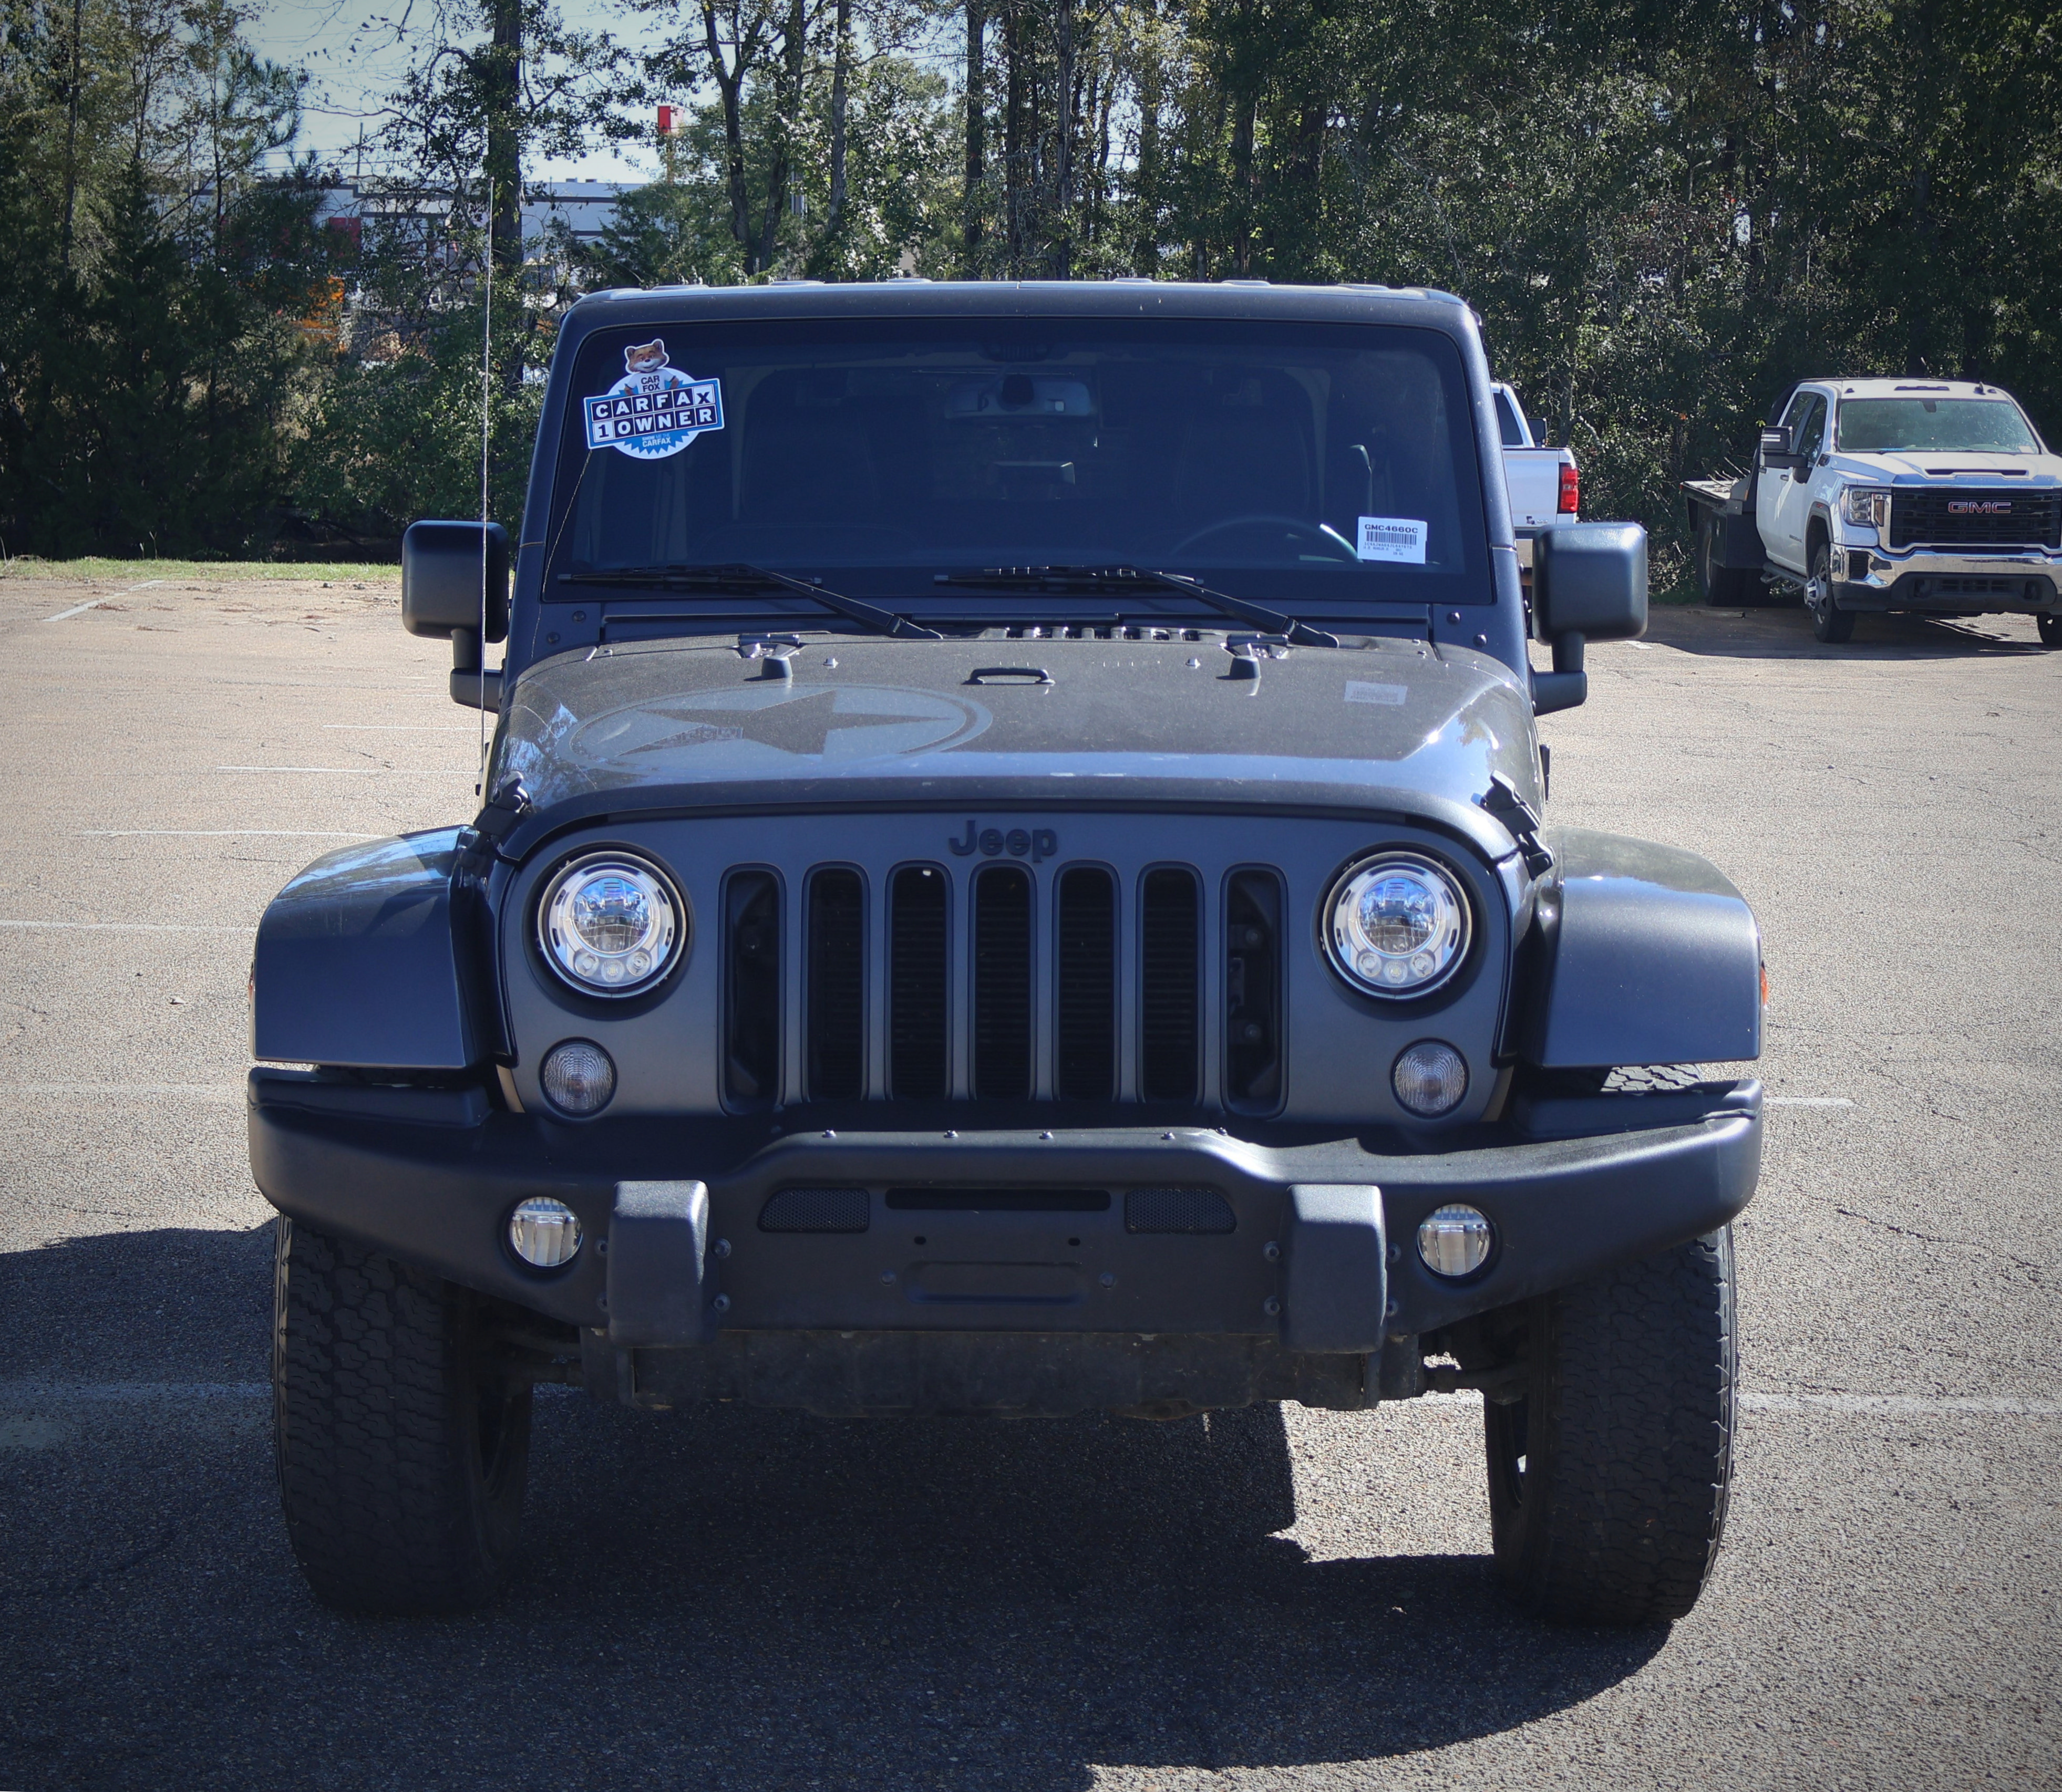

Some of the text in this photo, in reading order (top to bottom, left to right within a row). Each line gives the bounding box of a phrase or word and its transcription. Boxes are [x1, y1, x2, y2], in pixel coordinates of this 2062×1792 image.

[641, 375, 660, 385] CAR
[643, 384, 661, 392] FOX
[595, 391, 711, 418] CARFAX
[642, 437, 671, 447] CARFAX
[1948, 501, 2012, 514] GMC
[1365, 524, 1418, 533] GMC4660C
[948, 820, 1058, 863] Jeep
